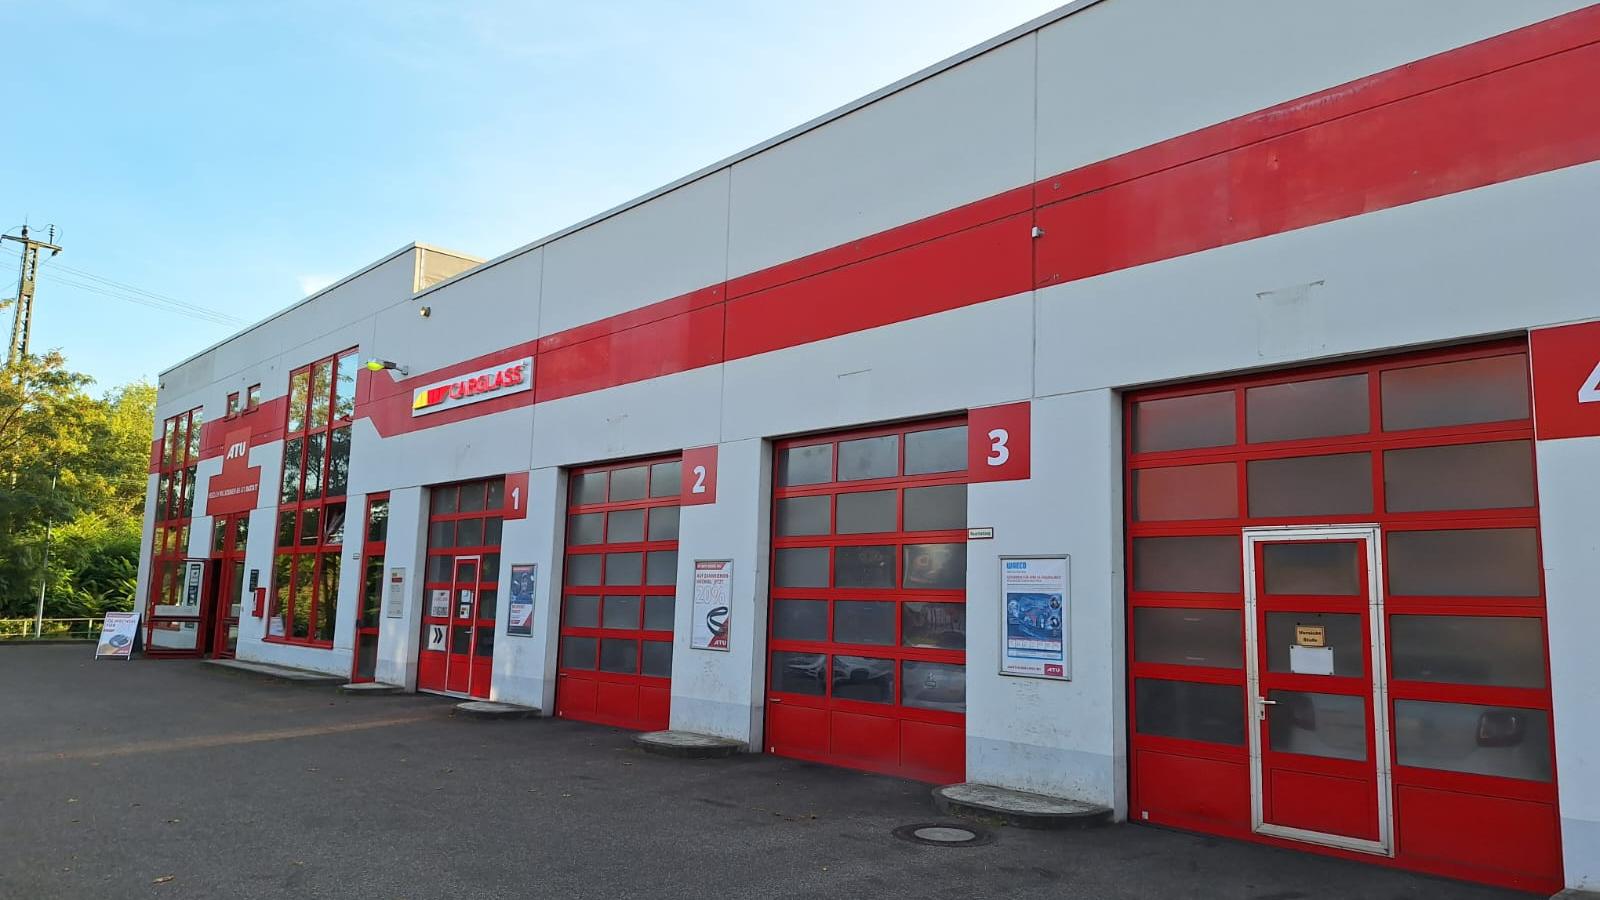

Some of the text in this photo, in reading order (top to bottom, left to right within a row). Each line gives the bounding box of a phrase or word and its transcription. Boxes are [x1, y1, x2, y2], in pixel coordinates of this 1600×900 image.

[226, 441, 246, 460] ATU
[987, 428, 1009, 466] 3
[693, 465, 706, 493] 2
[512, 487, 520, 510] 1
[713, 639, 727, 647] ATU
